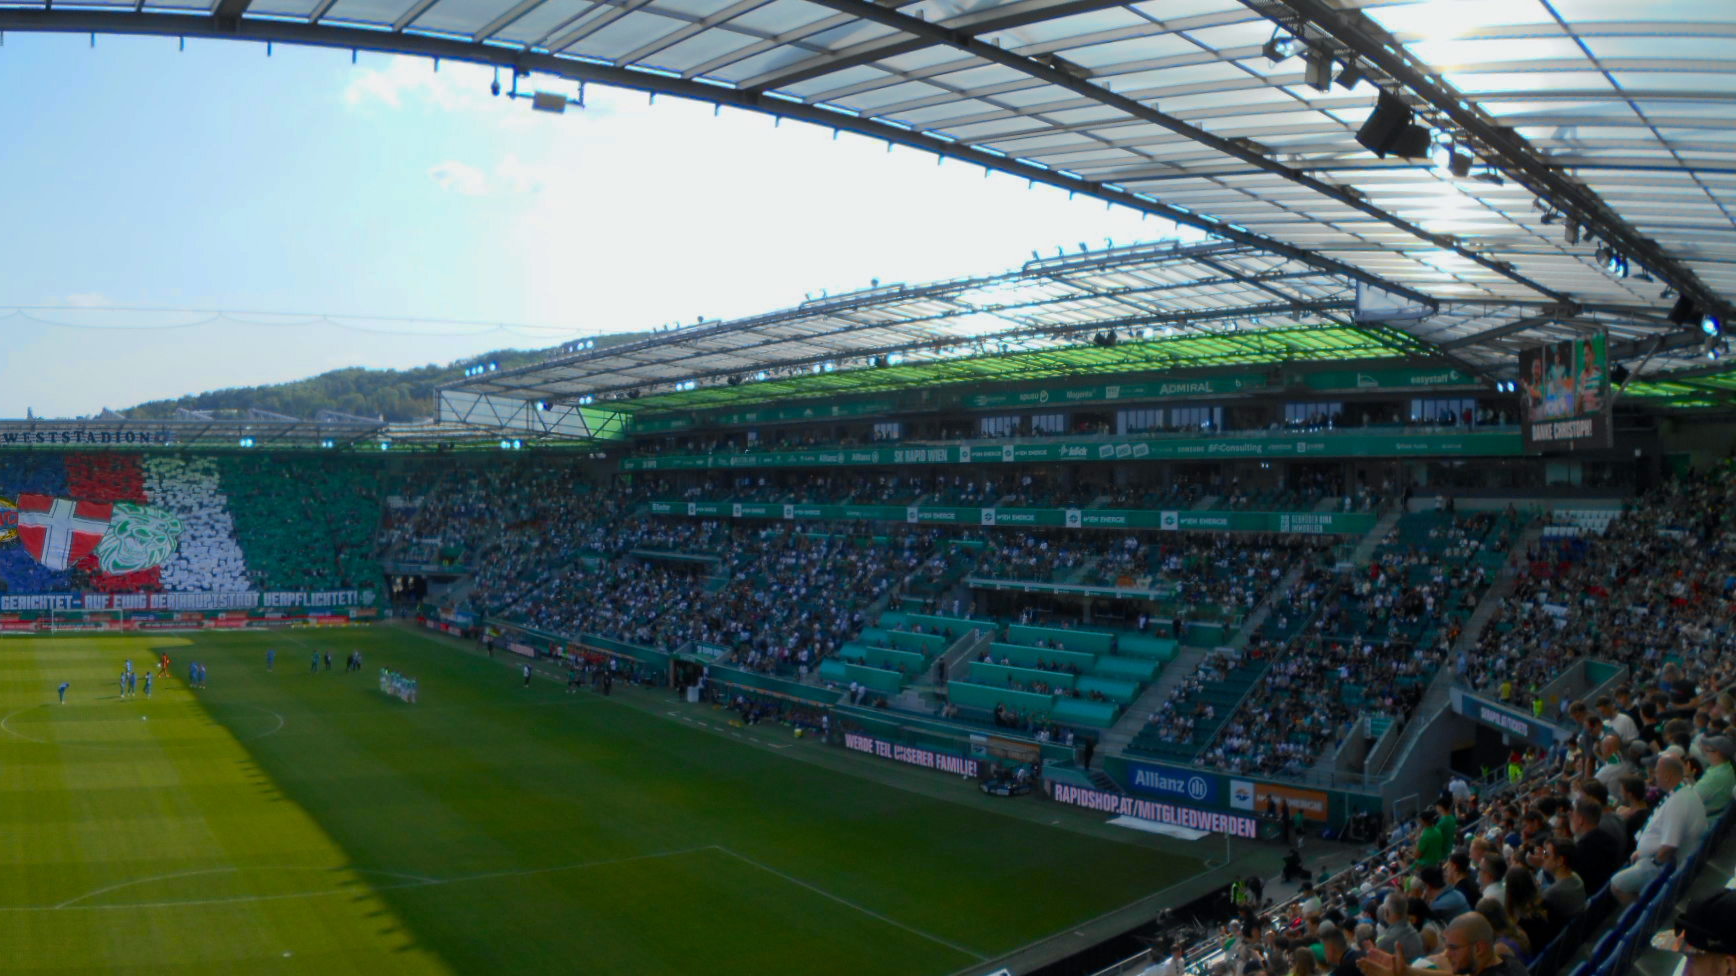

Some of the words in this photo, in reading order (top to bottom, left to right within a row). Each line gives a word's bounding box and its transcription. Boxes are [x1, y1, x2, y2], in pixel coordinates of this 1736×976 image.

[1159, 381, 1212, 395] ADMIRAL
[3, 431, 152, 444] WESTSTADION
[845, 733, 873, 753] WERDE
[874, 740, 893, 758] TEIL
[893, 744, 935, 768] UNSERER
[935, 753, 978, 777] FAMILIE!
[1134, 769, 1185, 793] Allianz
[1054, 783, 1257, 839] RAPIDSHOP.AT/MITGLIEDWERDEN
